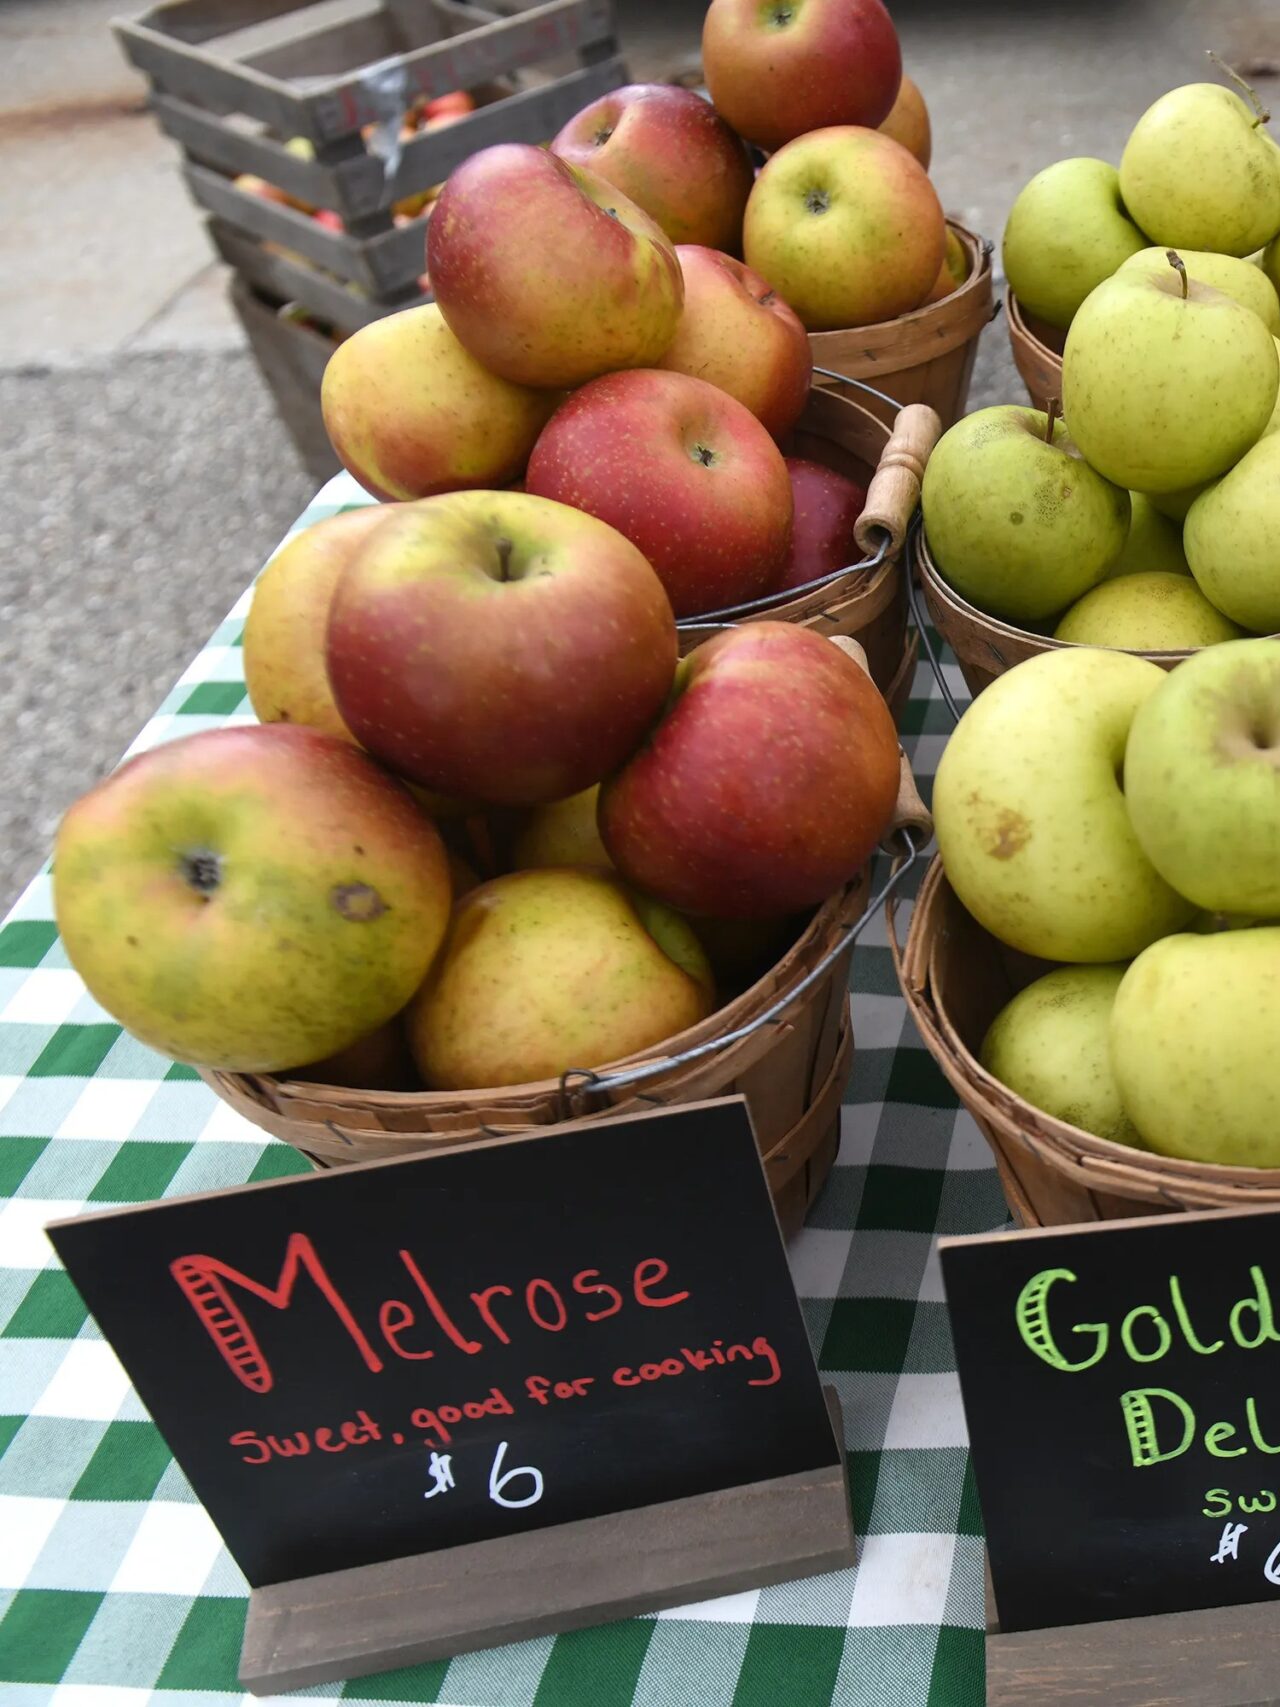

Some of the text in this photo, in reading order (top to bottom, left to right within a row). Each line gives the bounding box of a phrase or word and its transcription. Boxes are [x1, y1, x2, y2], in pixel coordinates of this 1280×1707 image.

[169, 1231, 690, 1393] Melrose
[411, 1387, 515, 1446] good
[525, 1375, 595, 1405] for
[612, 1336, 782, 1388] cooking
